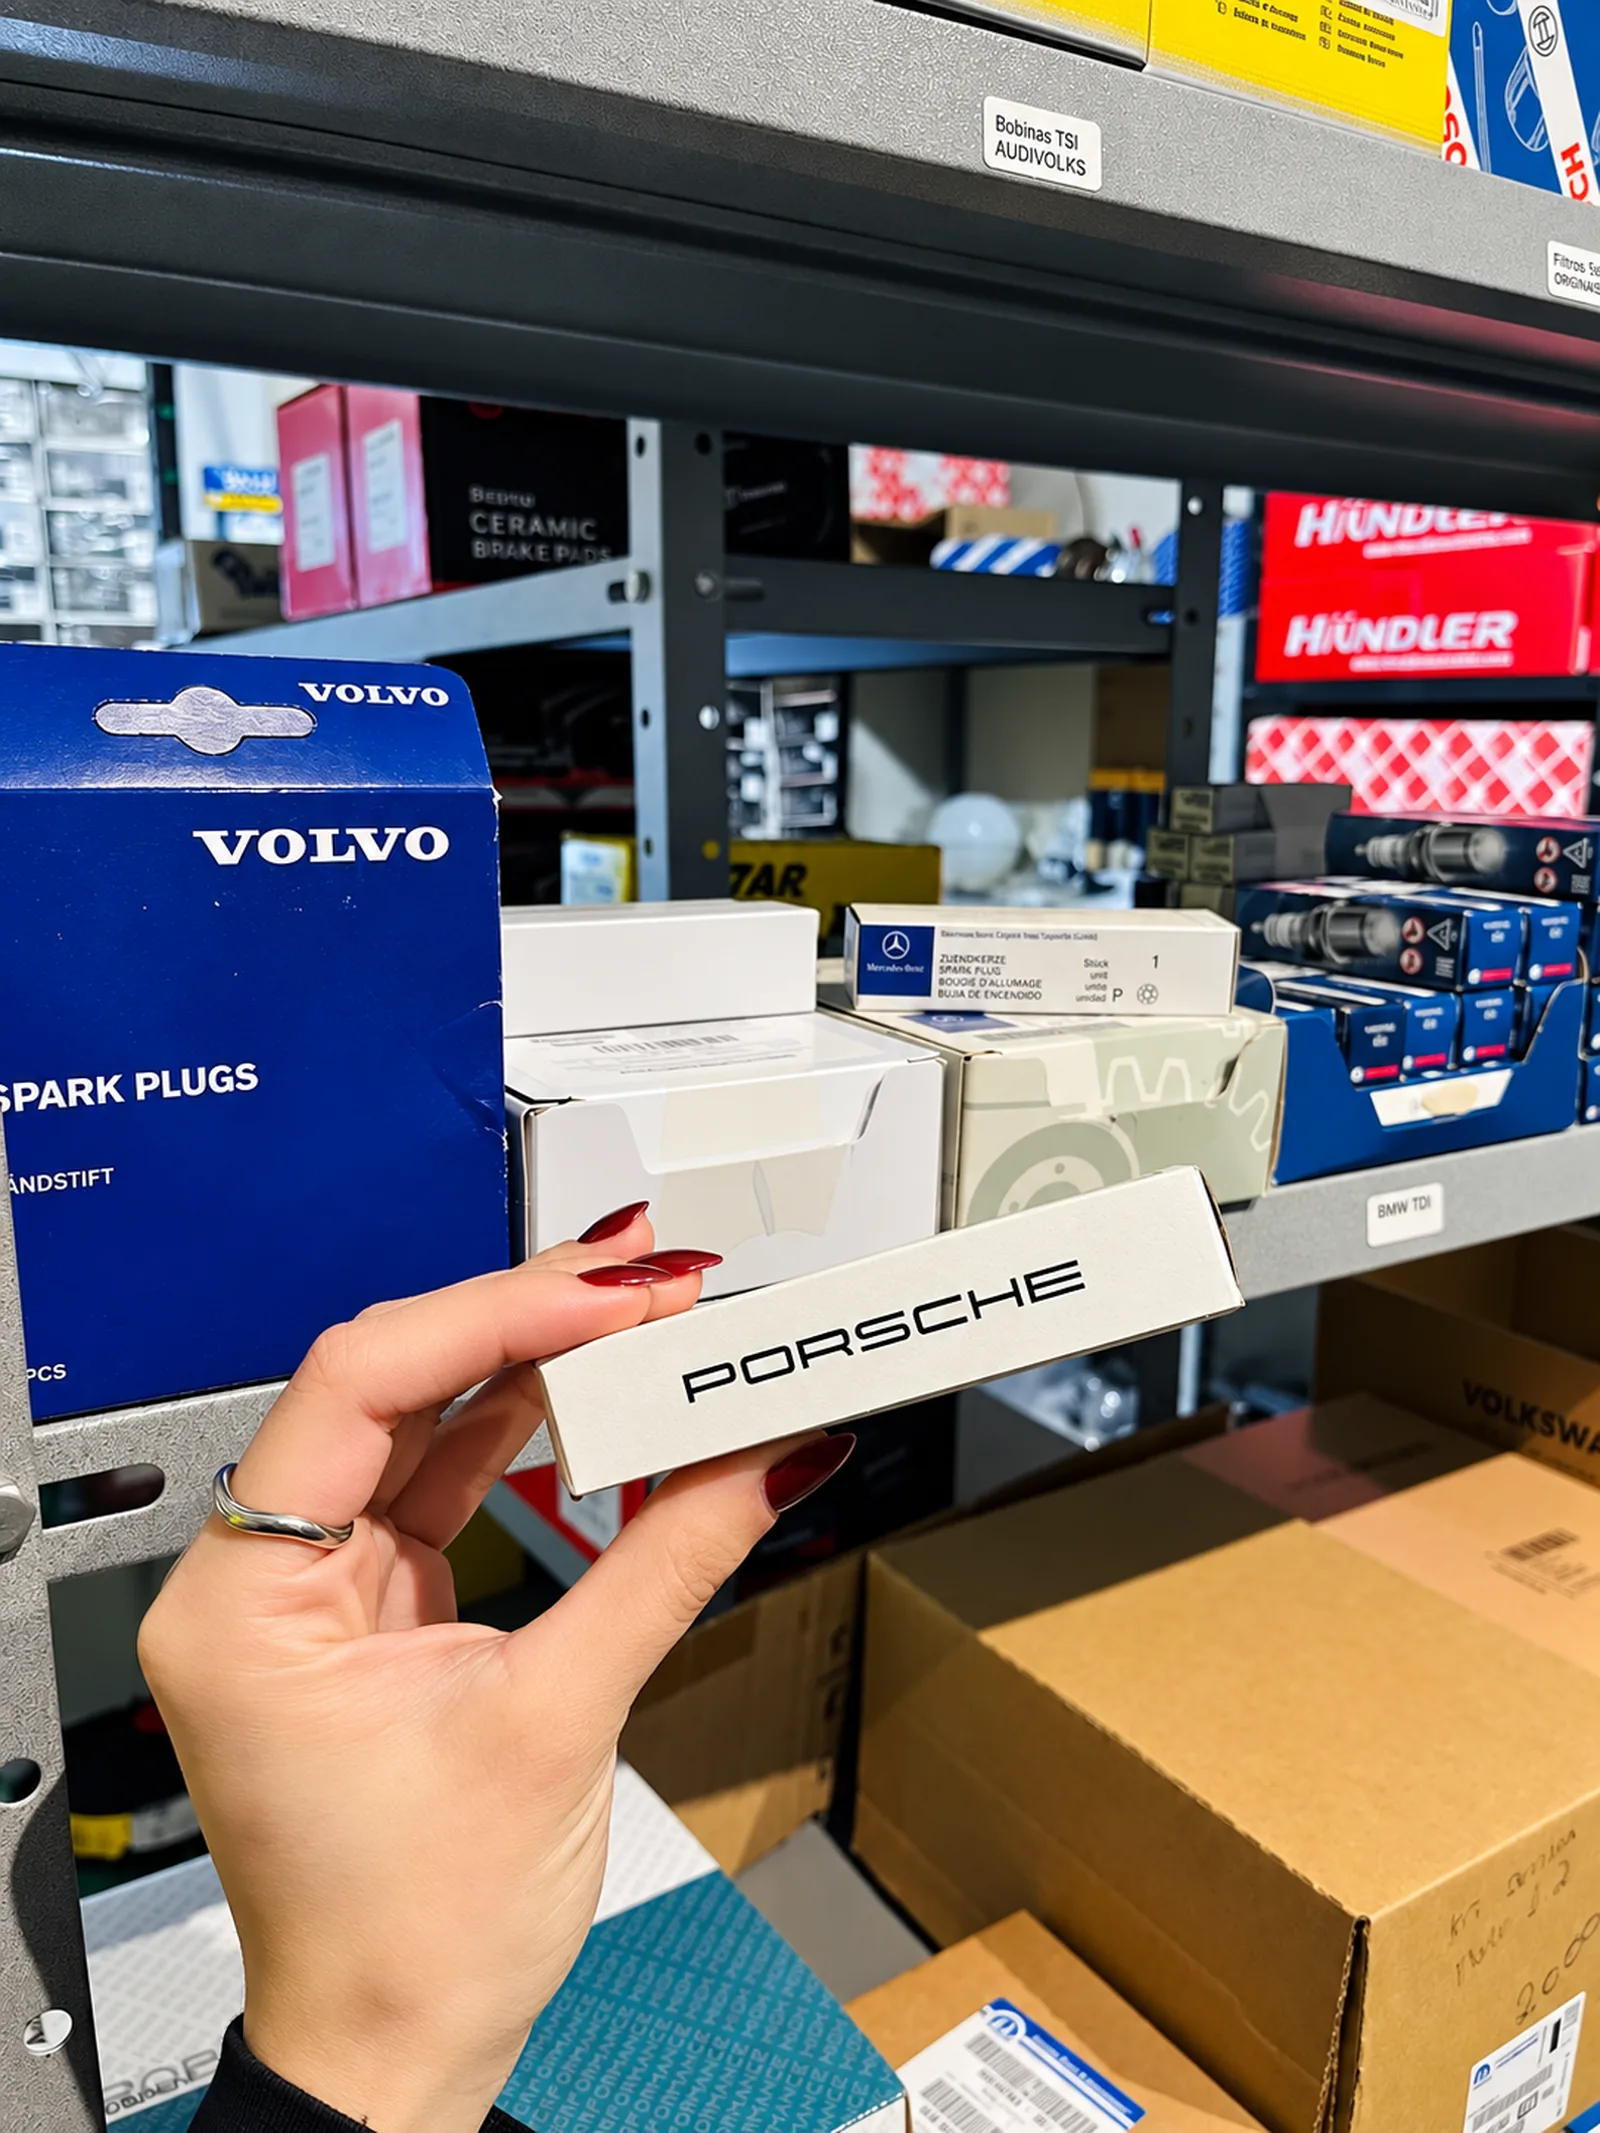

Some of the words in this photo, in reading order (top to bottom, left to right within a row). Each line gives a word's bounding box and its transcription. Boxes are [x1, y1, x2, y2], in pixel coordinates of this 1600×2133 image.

[996, 114, 1052, 144] Bobinas
[1055, 129, 1078, 150] TSI
[995, 140, 1086, 176] AUDIVOLKS
[469, 511, 597, 540] CERAMIC
[472, 539, 549, 561] BRAKE
[298, 683, 449, 706] VOLVO
[193, 826, 449, 865] VOLVO
[1152, 954, 1159, 969] 1
[968, 989, 981, 999] DE
[0, 1073, 125, 1113] SPARK
[135, 1062, 259, 1100] PLUGS
[1377, 1199, 1408, 1219] BMW
[1413, 1195, 1431, 1211] TDI
[682, 1259, 1086, 1404] PORSCHE
